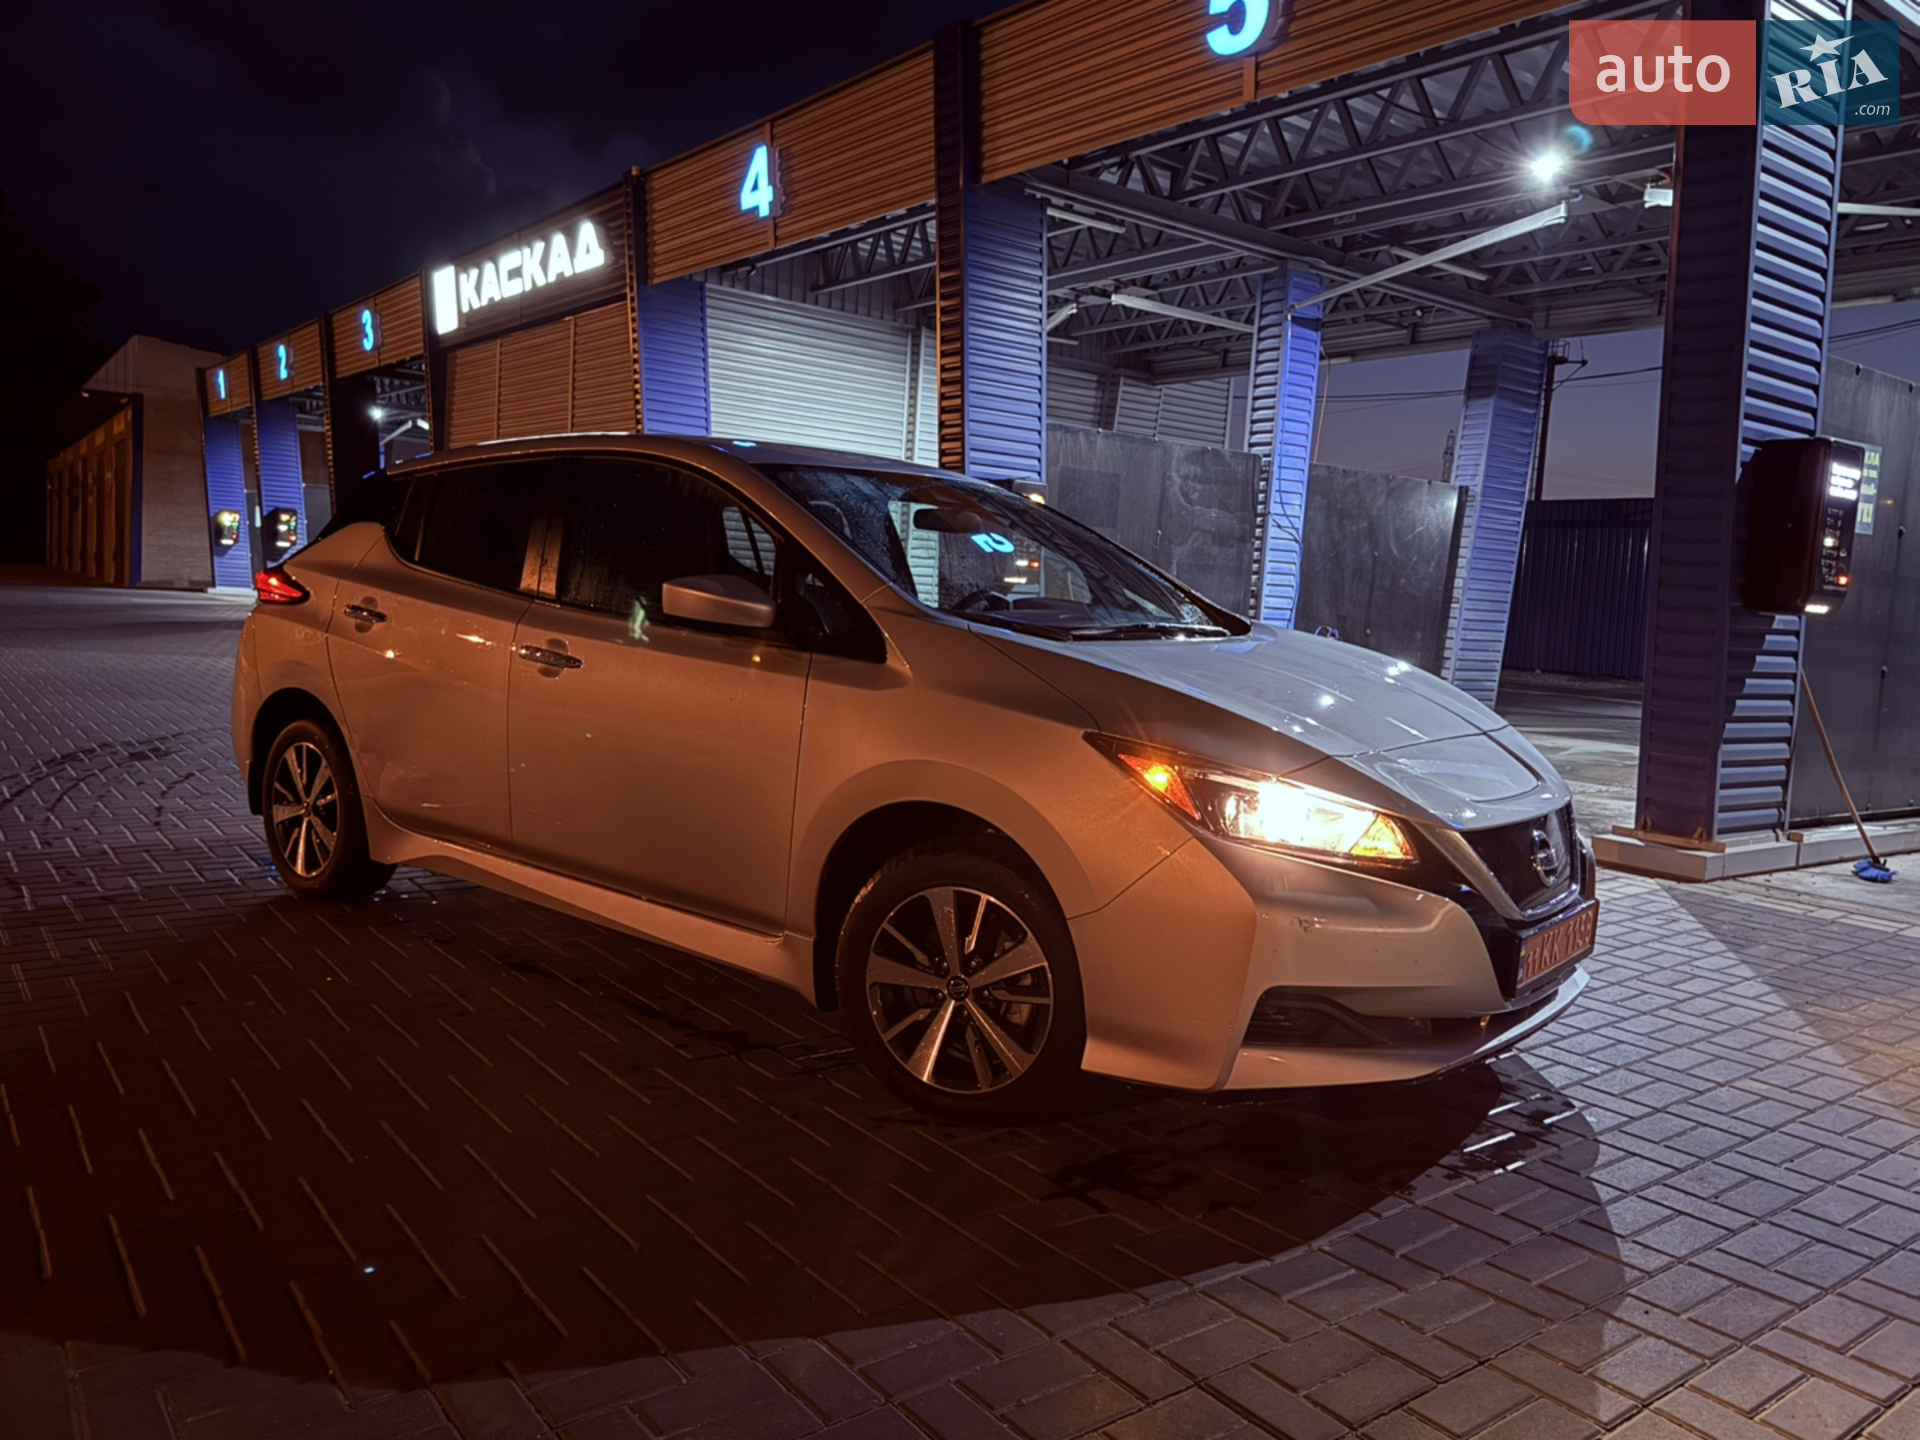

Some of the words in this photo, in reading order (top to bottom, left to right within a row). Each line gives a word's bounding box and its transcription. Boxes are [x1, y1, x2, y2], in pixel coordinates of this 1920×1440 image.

[1206, 0, 1270, 56] 5
[739, 144, 774, 219] 4
[458, 220, 606, 314] КАСКАД
[361, 309, 375, 352] 3
[216, 369, 227, 400] 1
[276, 343, 289, 380] 2
